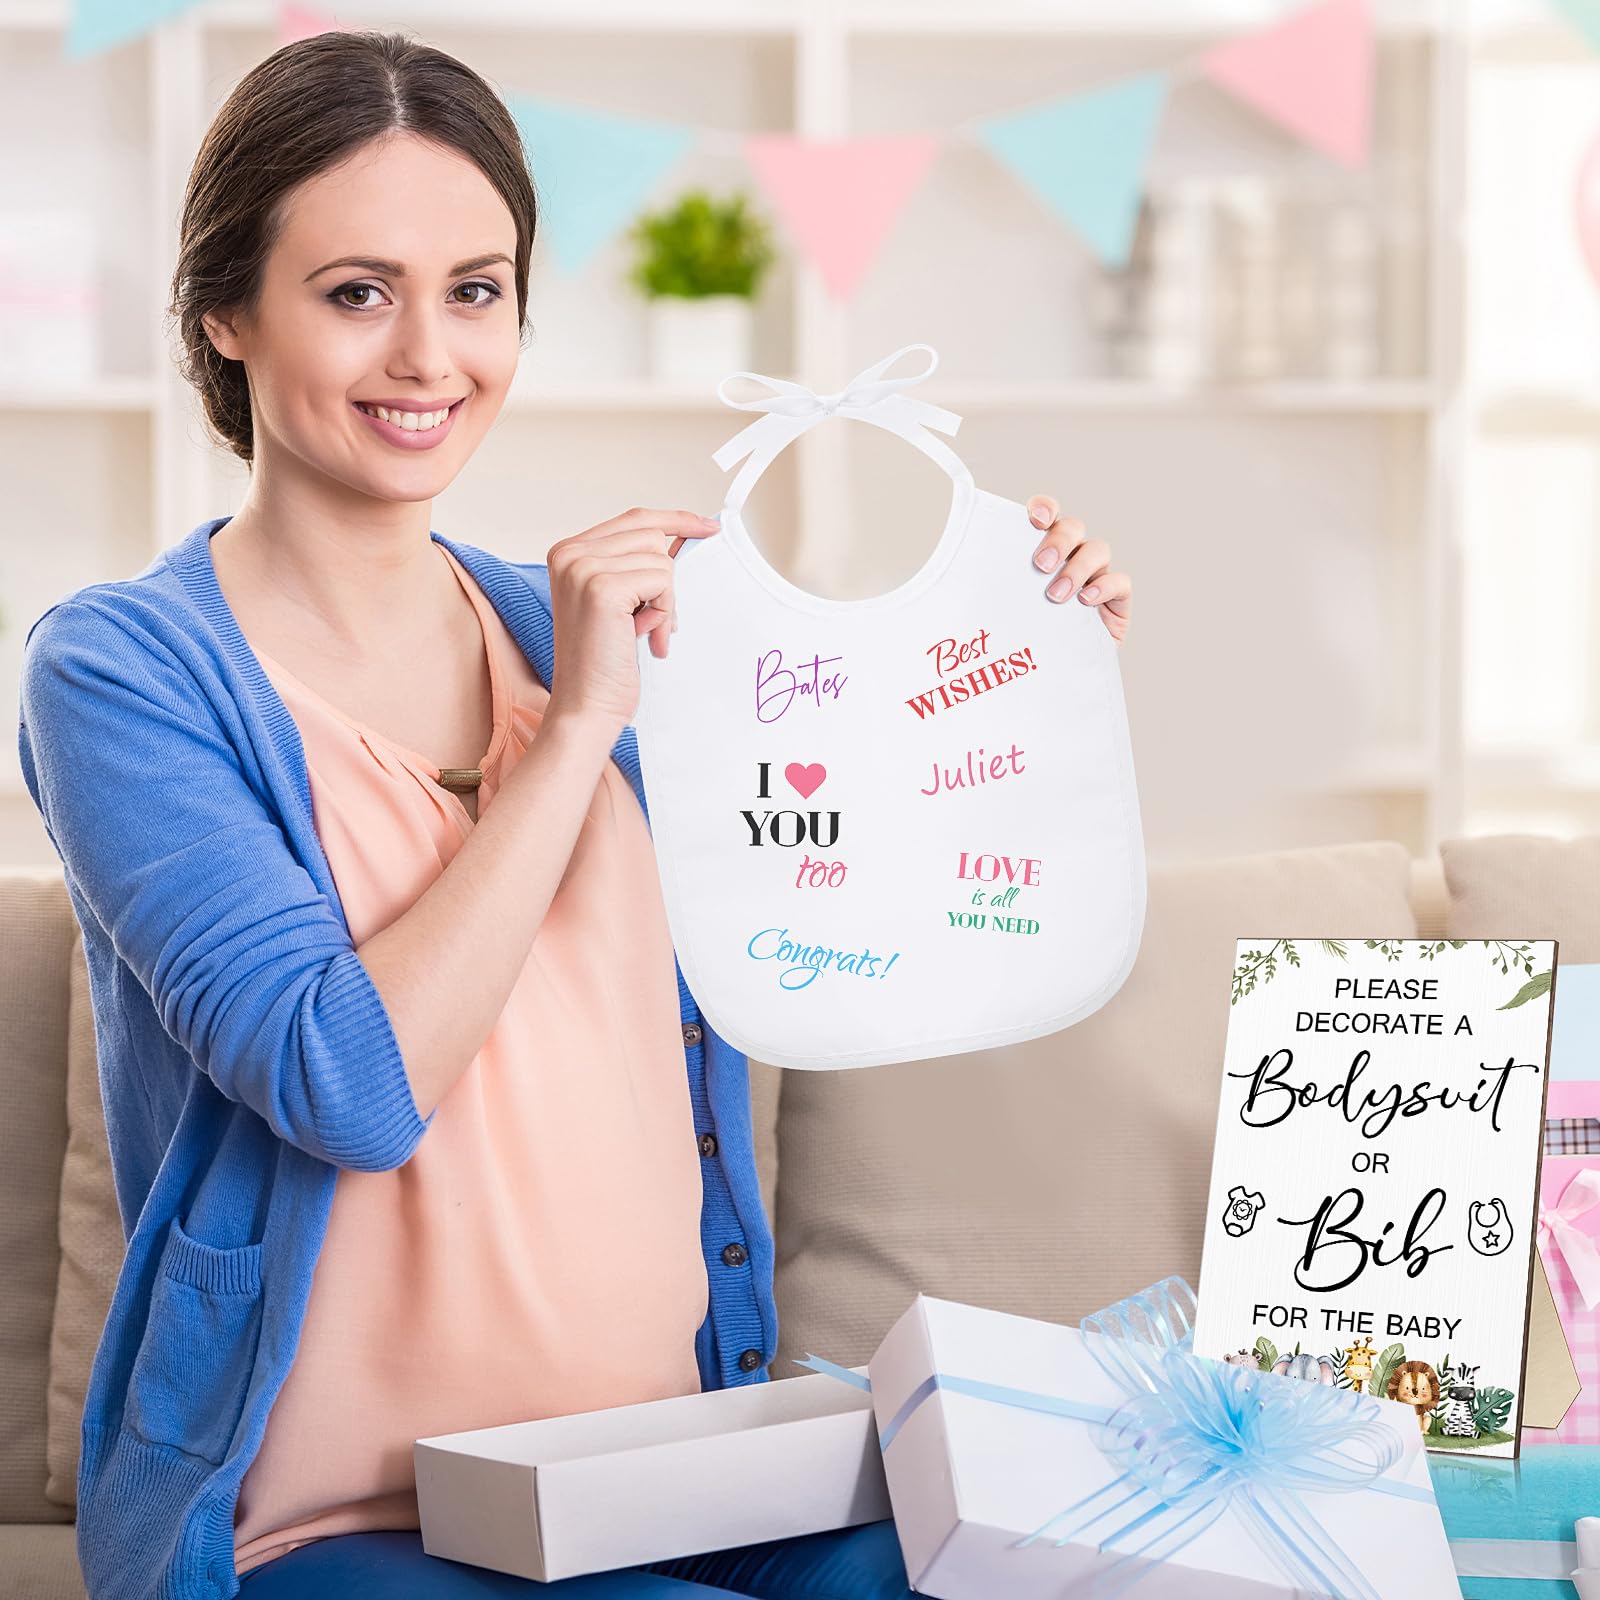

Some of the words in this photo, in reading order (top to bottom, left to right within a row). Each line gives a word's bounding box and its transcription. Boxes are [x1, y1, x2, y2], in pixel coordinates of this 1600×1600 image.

[927, 629, 991, 678] Best
[756, 649, 848, 723] Bates
[905, 647, 1038, 720] WISHES!
[757, 762, 772, 799] I
[921, 744, 1026, 796] Juliet
[740, 810, 841, 848] YOU
[795, 854, 848, 889] too
[957, 852, 1042, 887] LOVE
[972, 888, 984, 907] is
[990, 887, 1019, 909] all
[947, 911, 987, 930] YOU
[992, 915, 1040, 935] NEED
[747, 928, 901, 991] Congrats!
[1335, 979, 1439, 1000] PLEASE
[1295, 1011, 1443, 1036] DECORATE
[1453, 1015, 1473, 1036] A
[1227, 1048, 1540, 1139] Bodysuit
[1351, 1152, 1390, 1174] OR
[1277, 1187, 1454, 1293] Bib
[1252, 1304, 1308, 1329] FOR
[1320, 1308, 1375, 1334] THE
[1386, 1314, 1462, 1340] BABY
